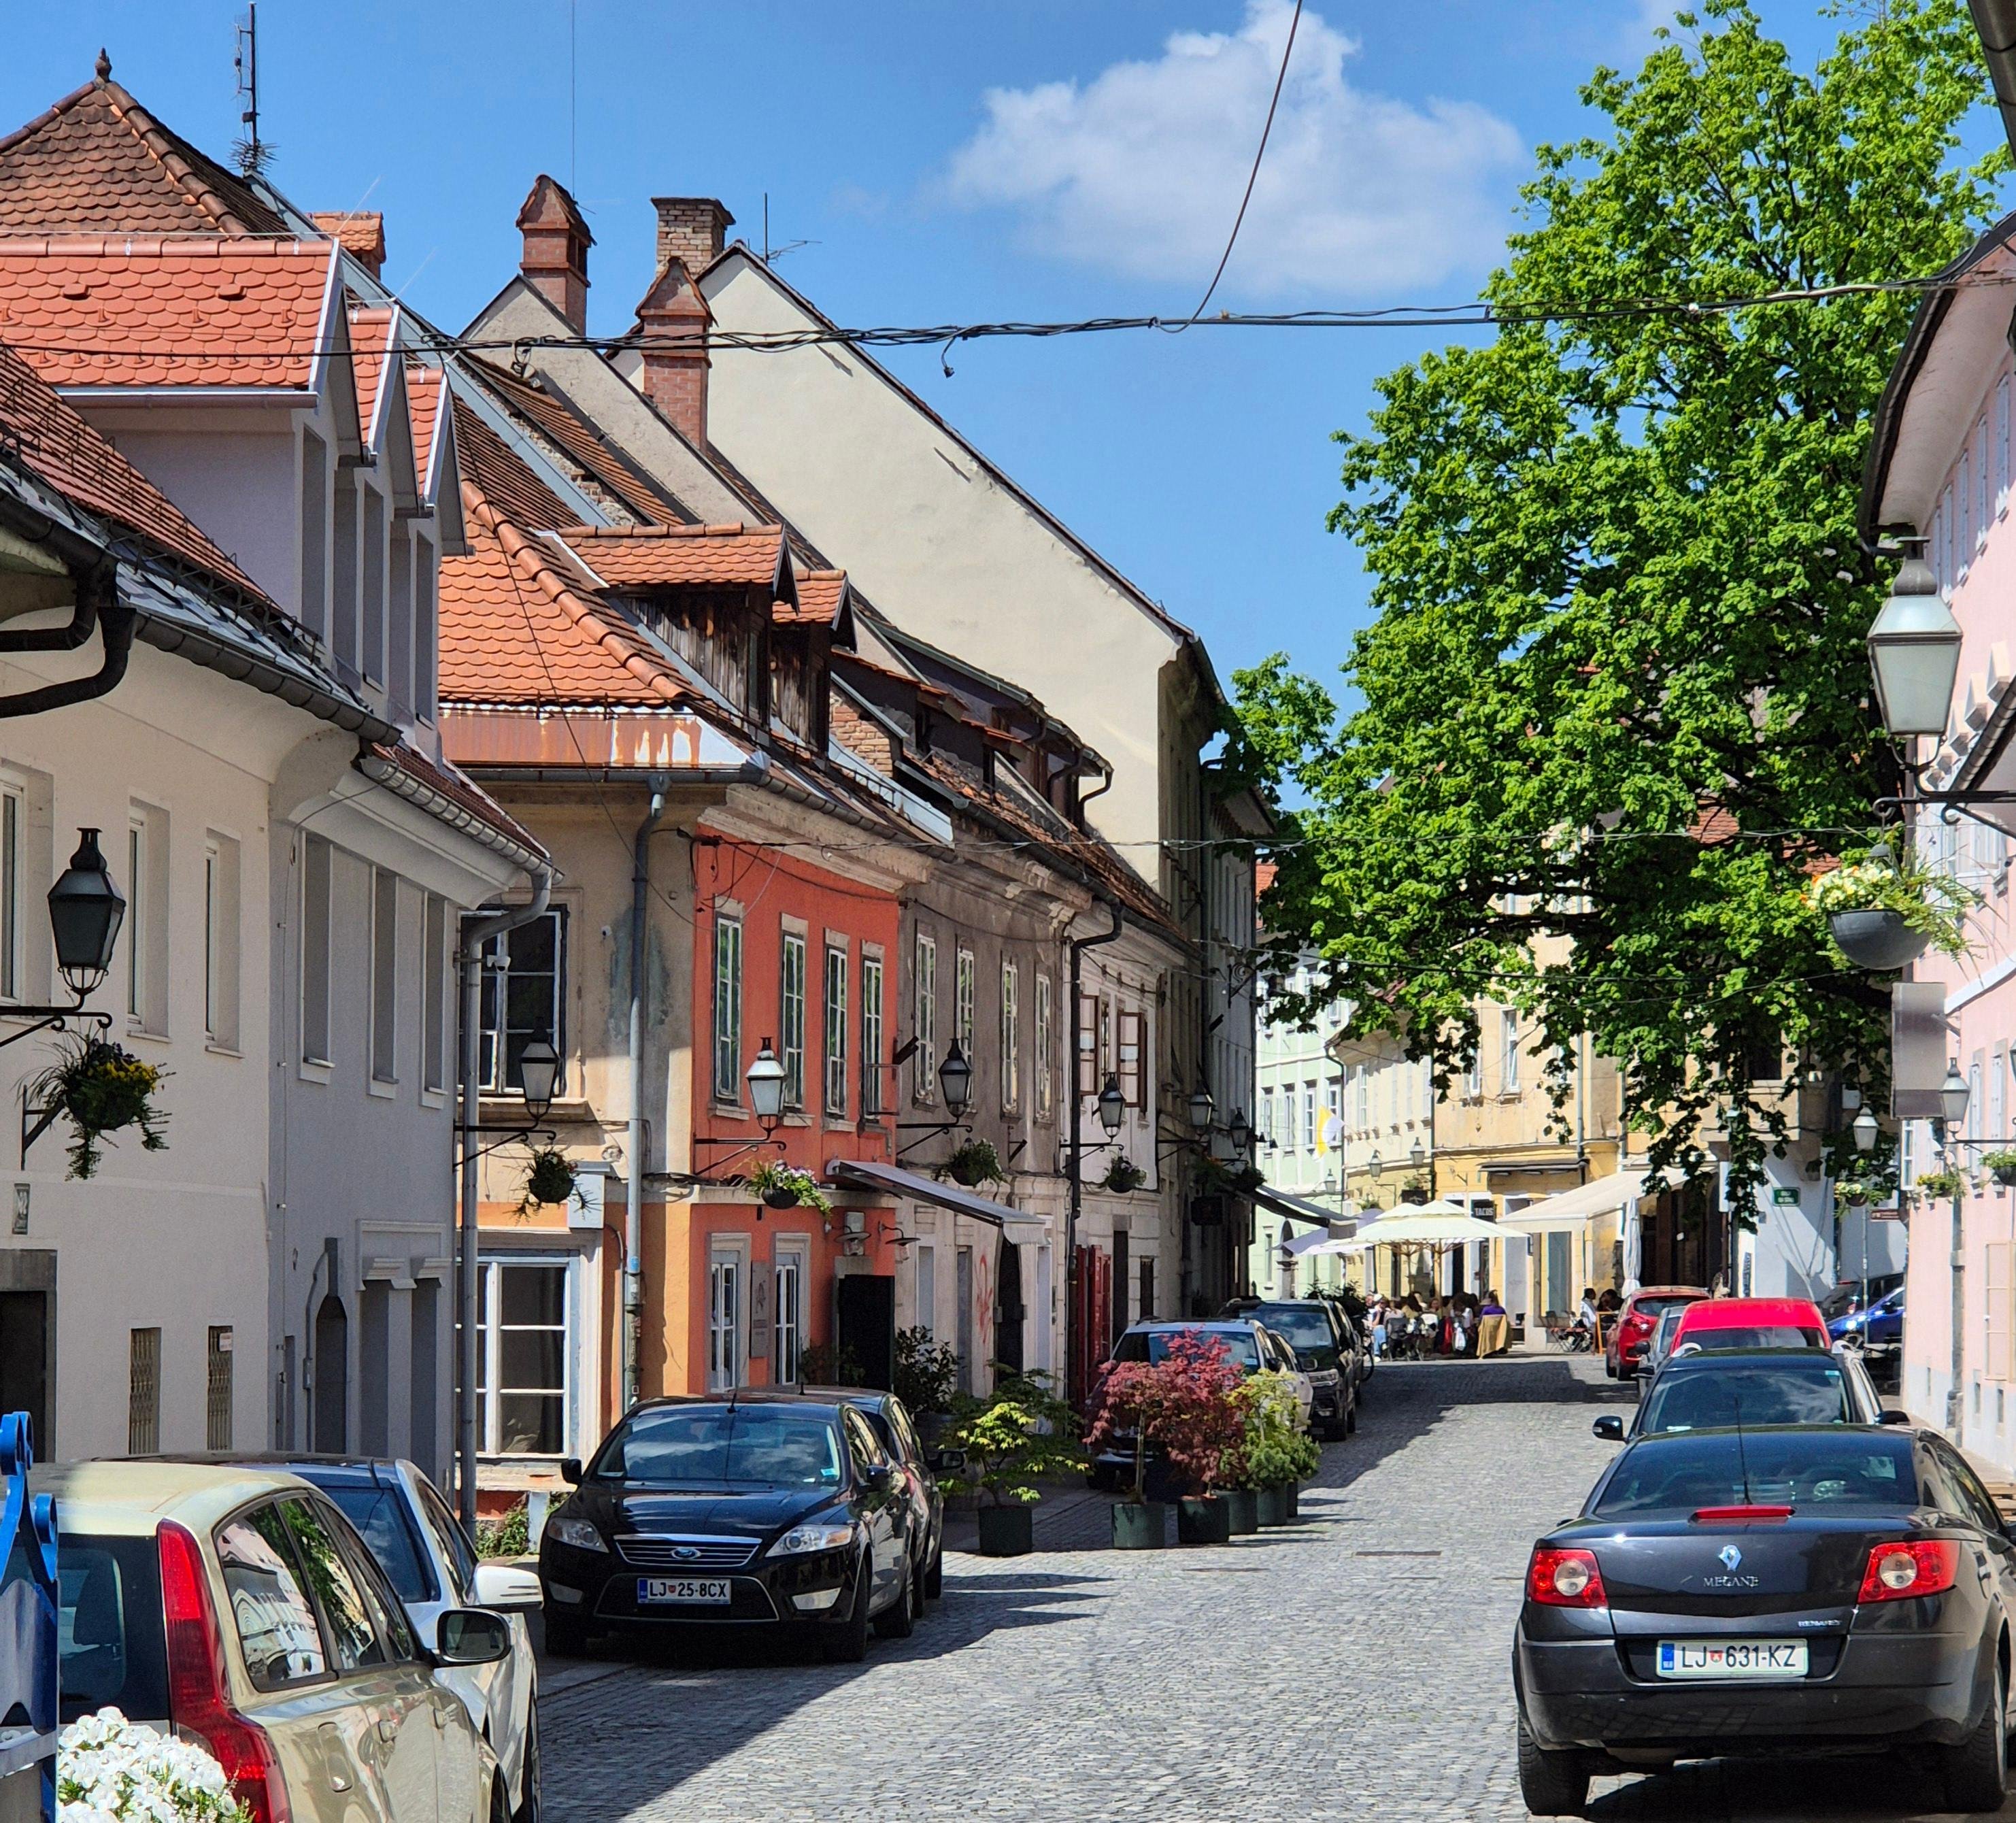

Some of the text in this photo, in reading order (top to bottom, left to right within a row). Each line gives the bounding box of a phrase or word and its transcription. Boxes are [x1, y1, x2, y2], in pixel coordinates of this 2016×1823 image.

[650, 1582, 726, 1597] LJ 25-8CX
[1681, 1645, 1796, 1668] LJ 631-KZ
